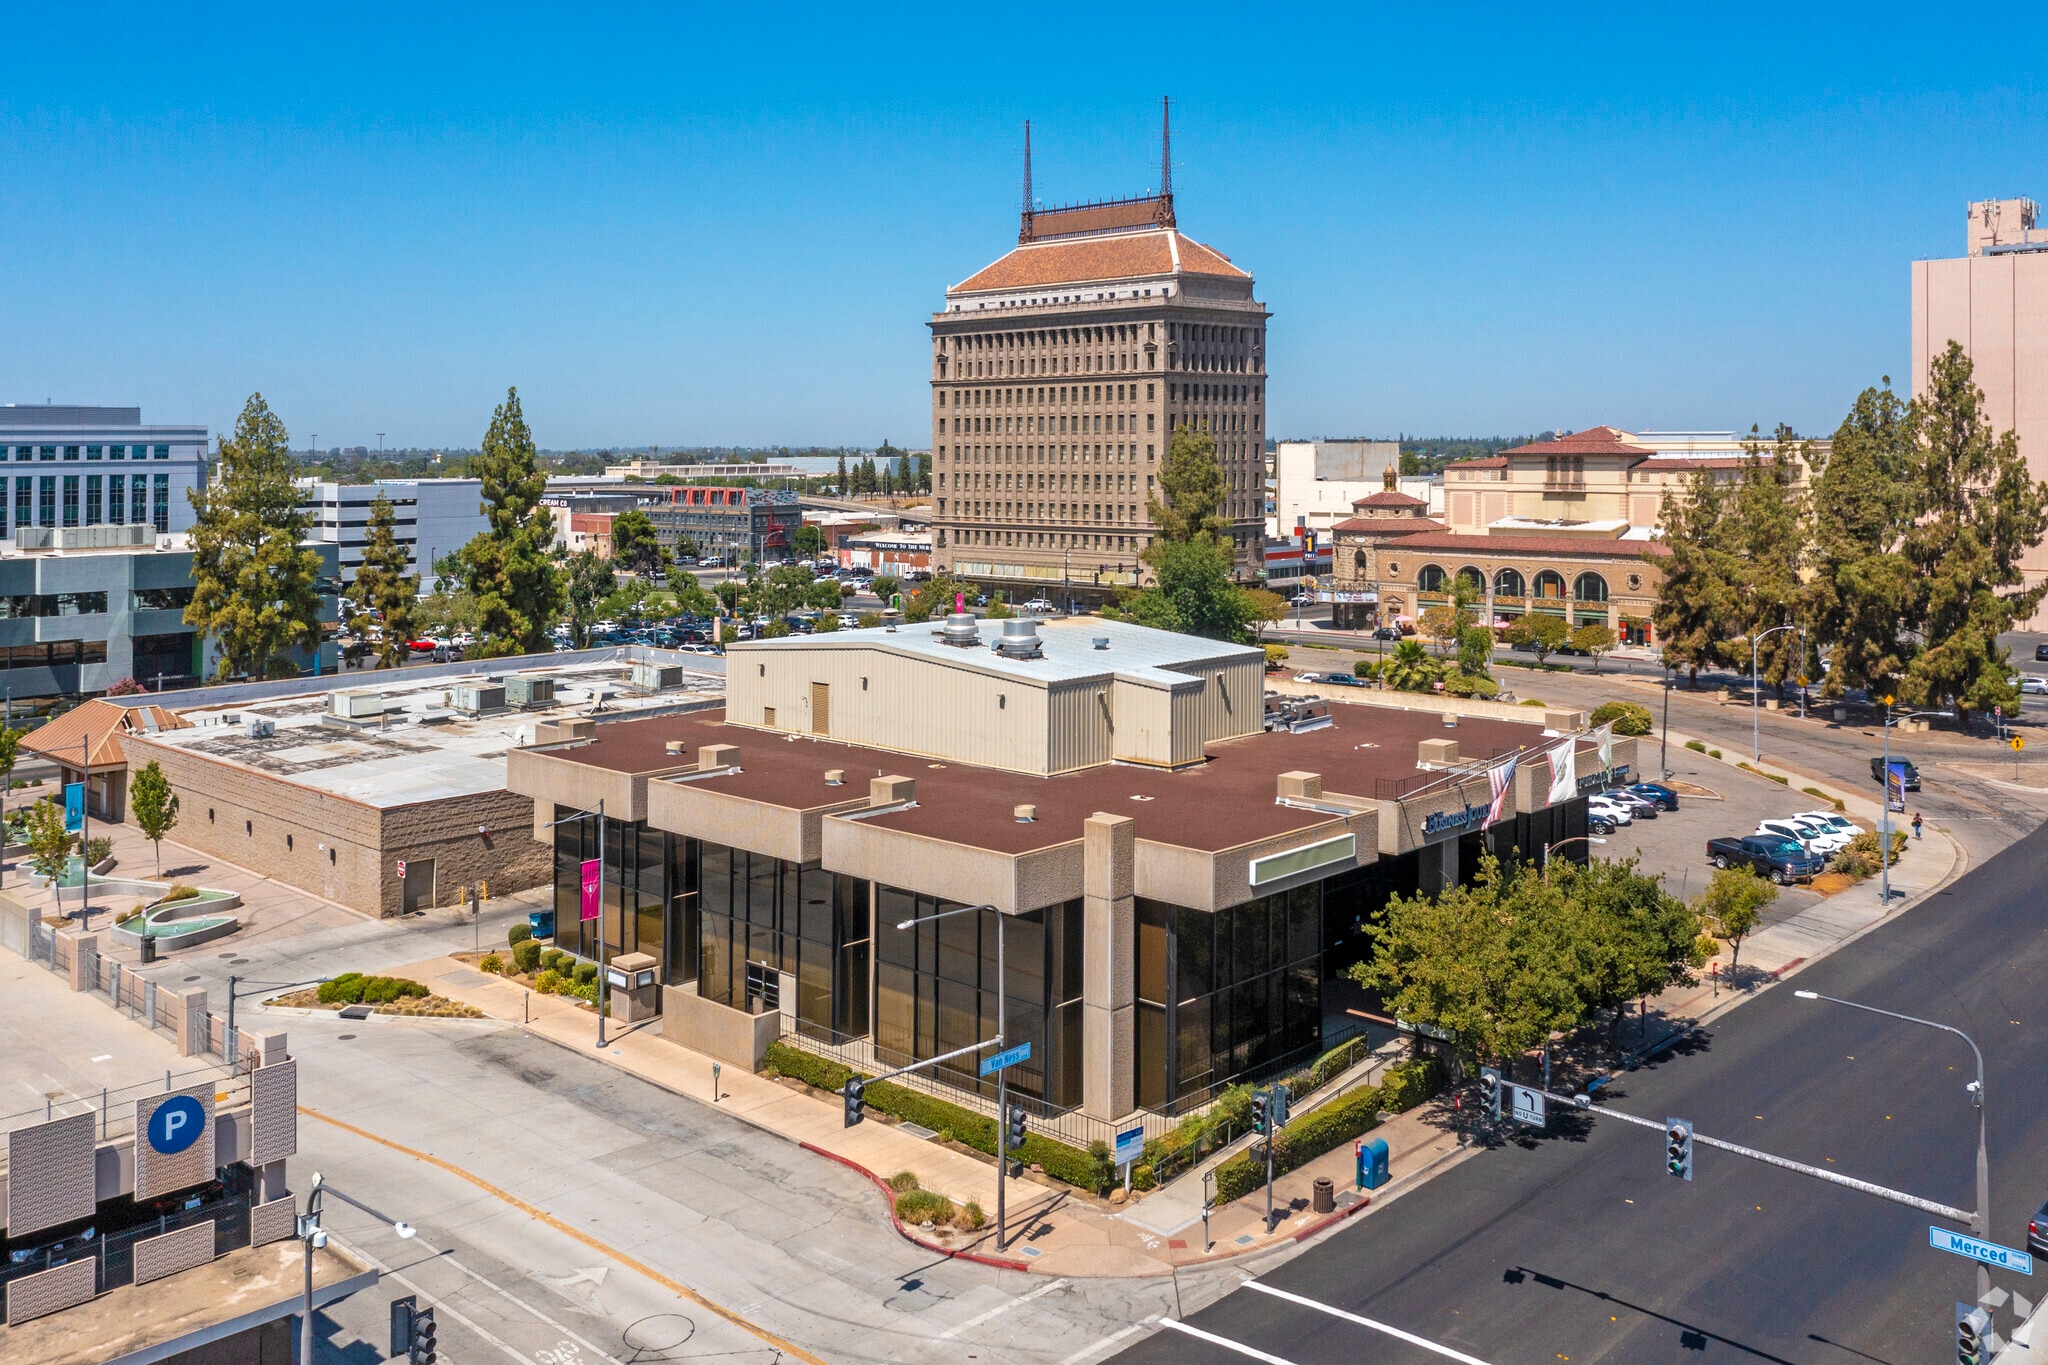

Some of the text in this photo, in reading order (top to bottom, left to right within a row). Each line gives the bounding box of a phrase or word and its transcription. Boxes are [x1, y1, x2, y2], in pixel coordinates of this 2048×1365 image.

[1305, 536, 1312, 552] 1
[991, 1058, 1003, 1069] Van
[1004, 1052, 1020, 1063] Ness
[165, 1110, 187, 1141] P
[1950, 1236, 2007, 1263] Merced
